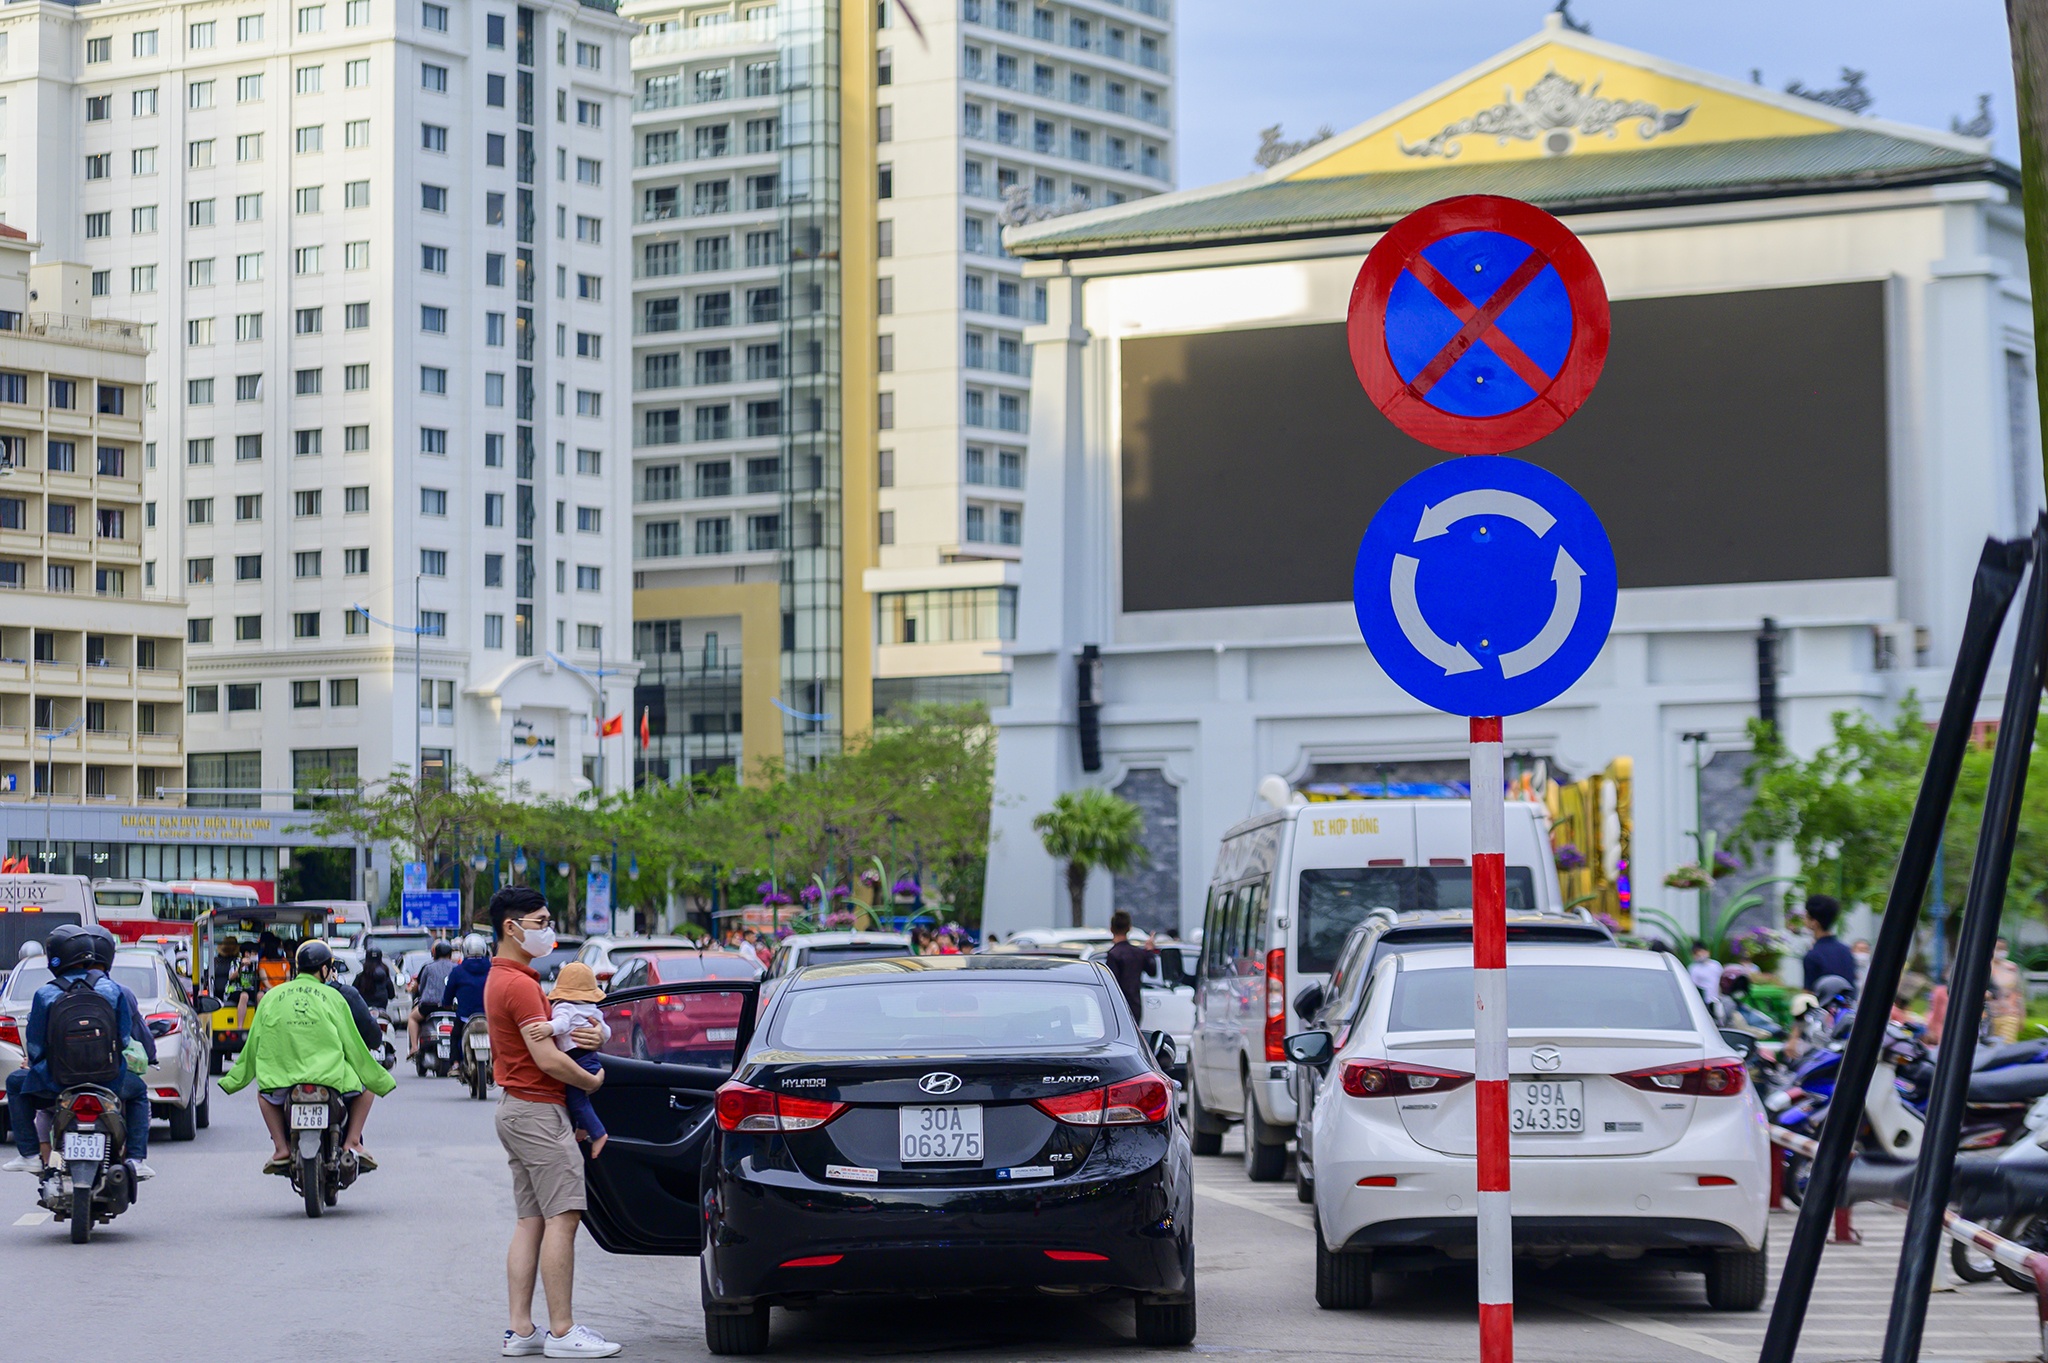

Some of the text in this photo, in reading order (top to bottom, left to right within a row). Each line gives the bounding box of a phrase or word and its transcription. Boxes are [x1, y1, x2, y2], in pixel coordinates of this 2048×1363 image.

[1312, 819, 1326, 836] XE
[781, 1078, 827, 1088] HYUNDAI
[1042, 1075, 1100, 1084] ELANTRA
[1527, 1084, 1566, 1106] 99A
[298, 1106, 323, 1116] 14-H3
[297, 1117, 323, 1127] 4268
[920, 1107, 962, 1131] 30A
[1513, 1108, 1581, 1130] 343.59
[904, 1133, 980, 1158] 063.75
[68, 1147, 101, 1159] 199.34
[1049, 1153, 1073, 1162] GLS
